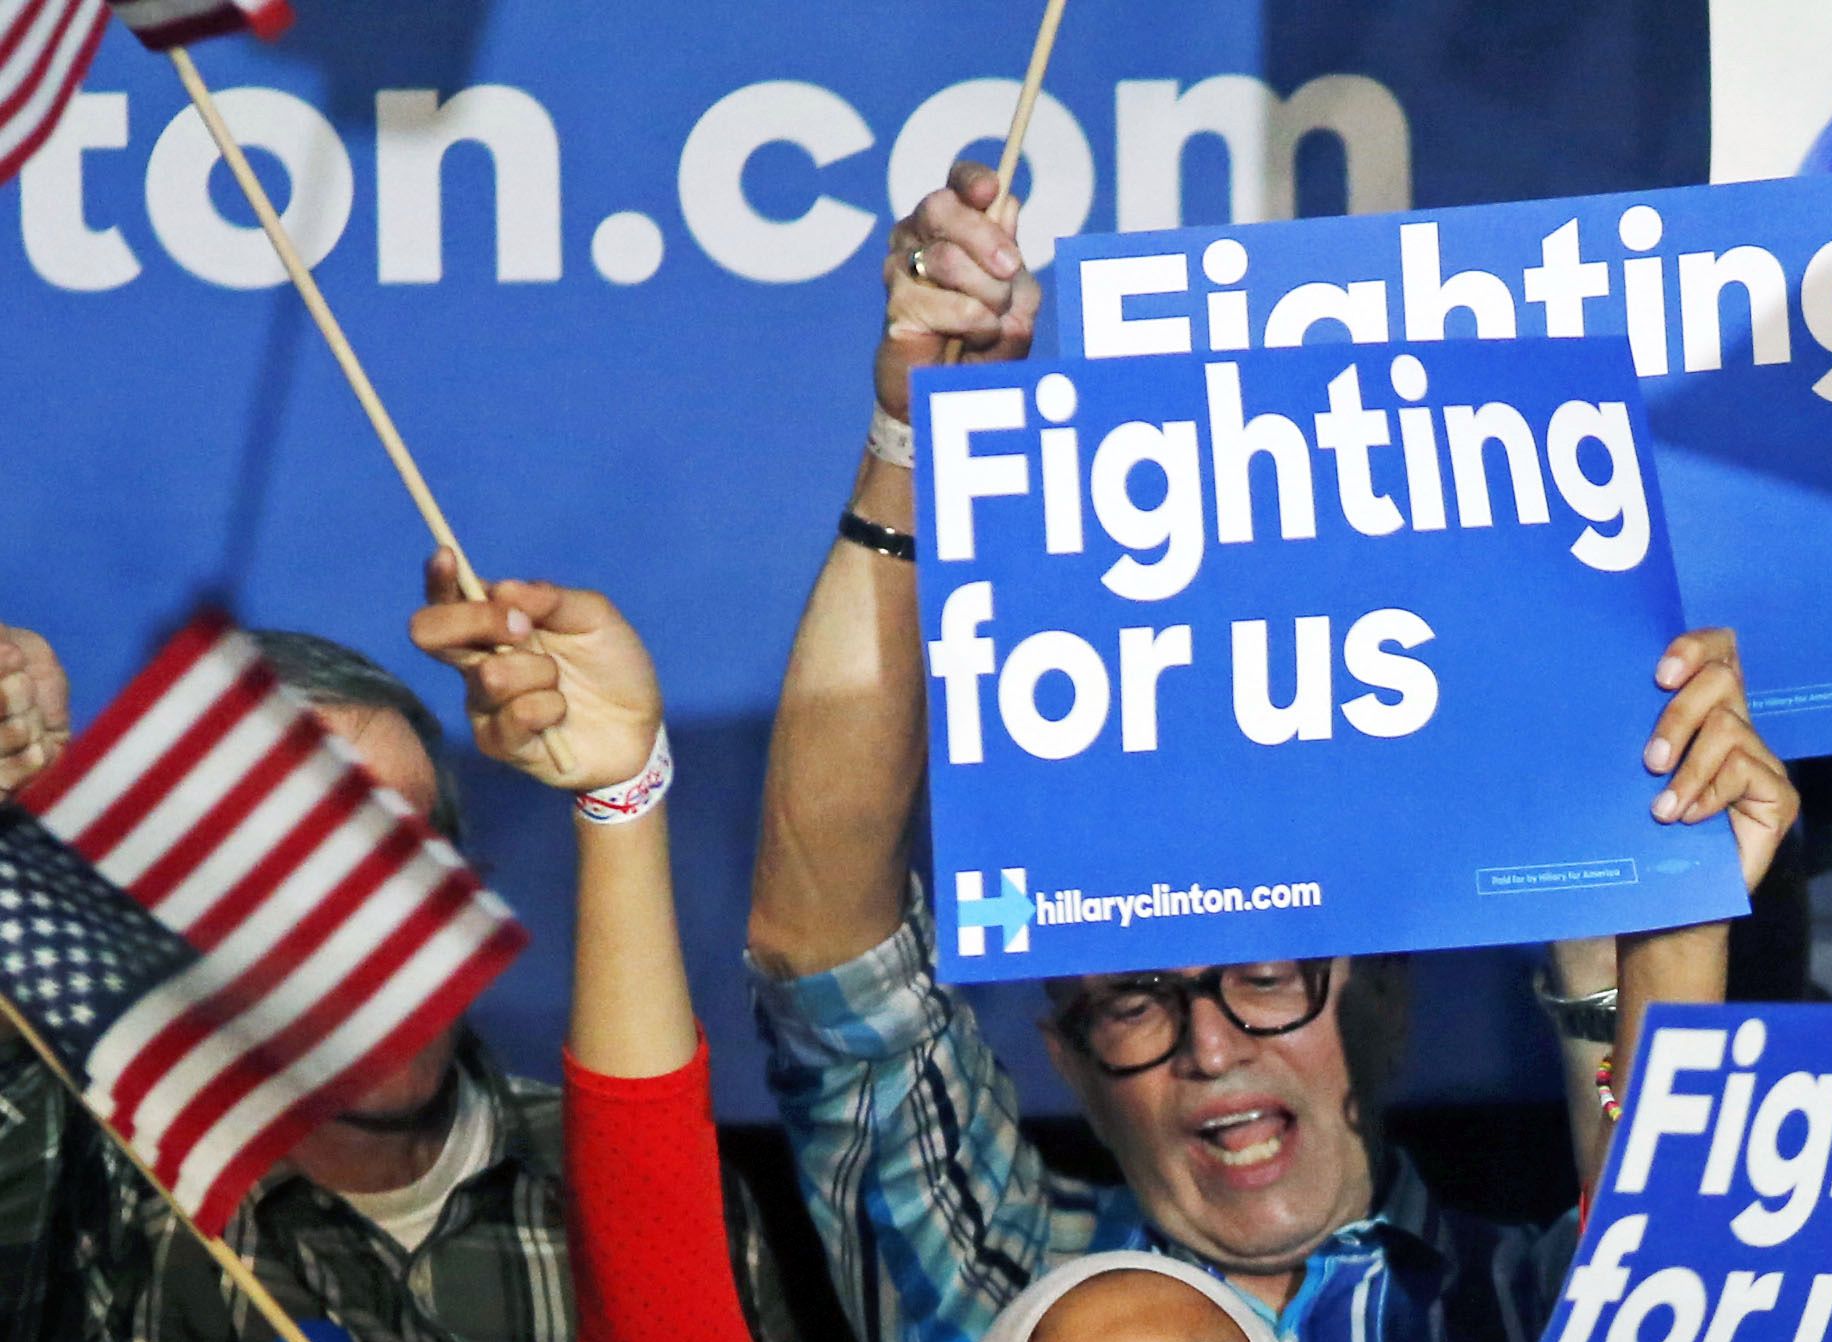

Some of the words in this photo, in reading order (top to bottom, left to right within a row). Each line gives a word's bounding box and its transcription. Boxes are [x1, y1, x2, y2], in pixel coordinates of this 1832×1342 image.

[20, 75, 1412, 292] ton.com
[929, 354, 1651, 603] Fighting
[927, 580, 1193, 765] for
[1231, 608, 1440, 746] us
[1036, 882, 1322, 927] hillaryclinton.com
